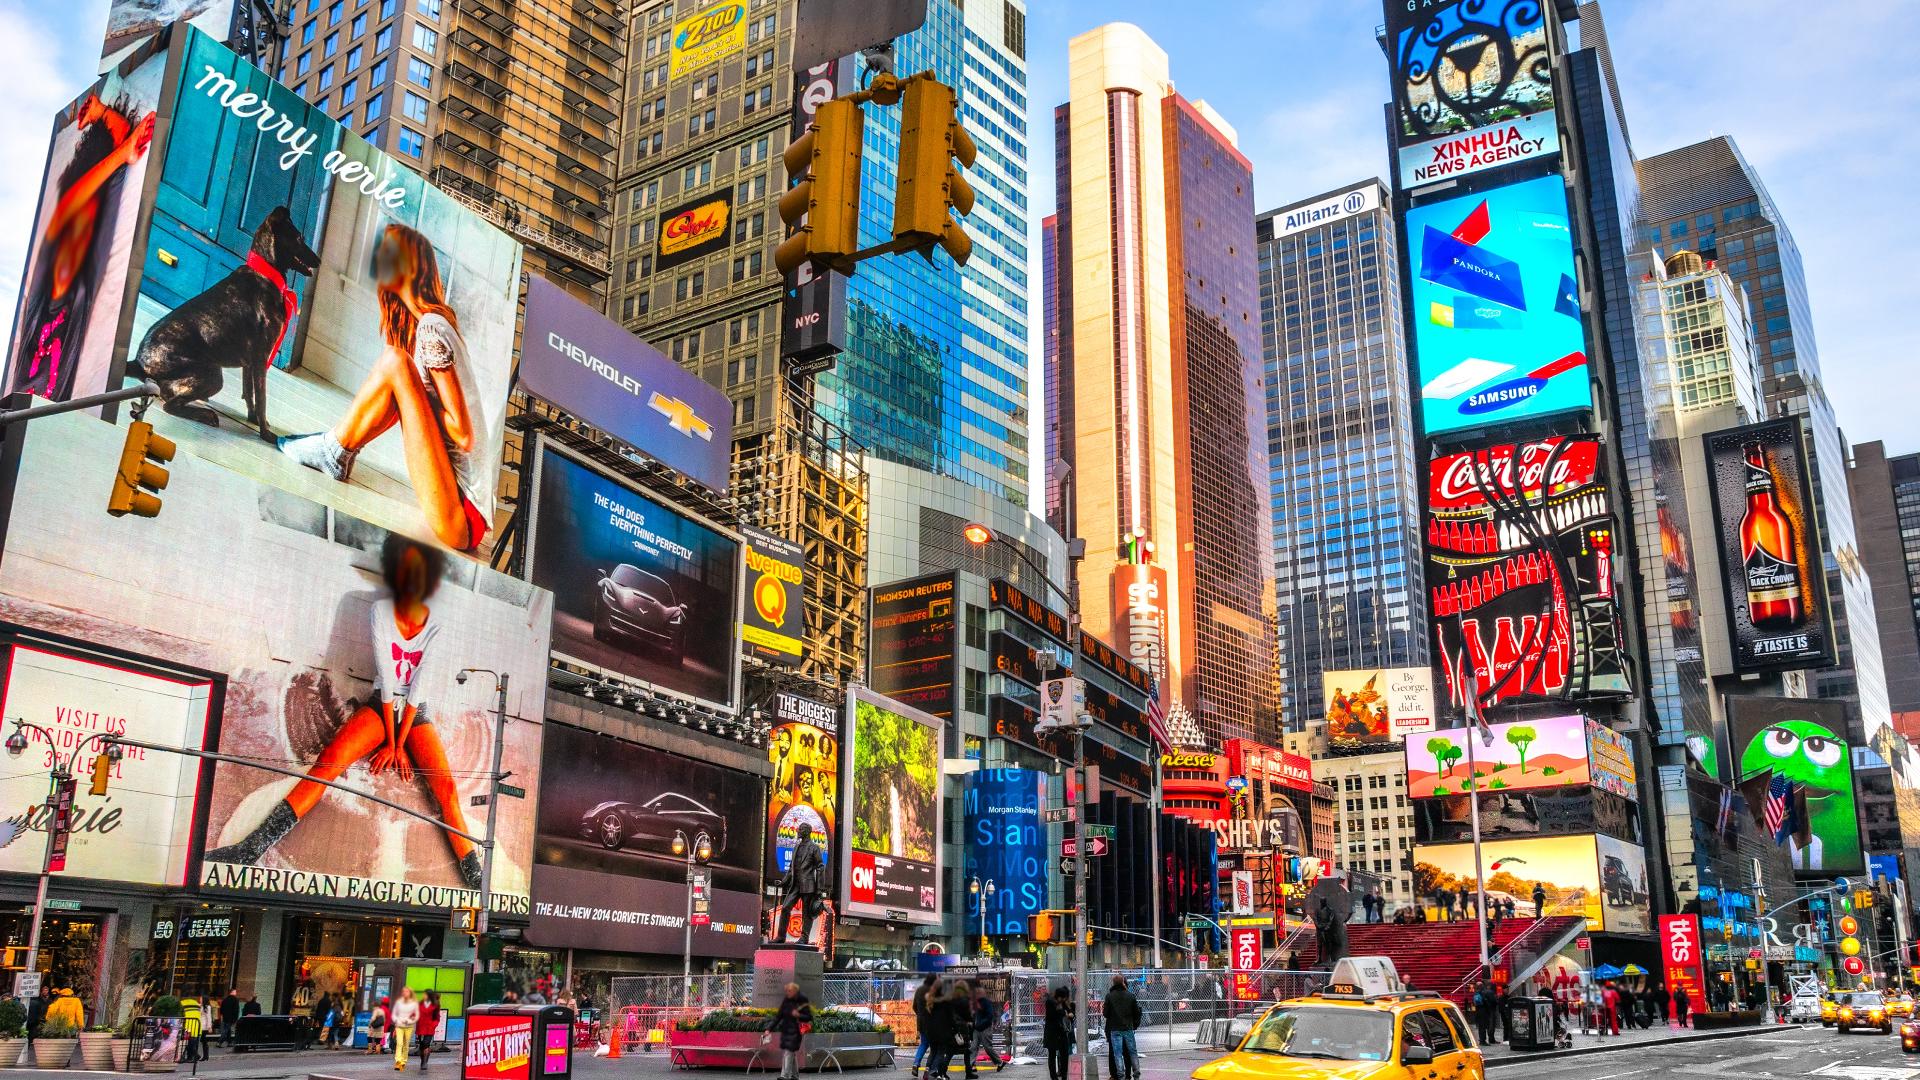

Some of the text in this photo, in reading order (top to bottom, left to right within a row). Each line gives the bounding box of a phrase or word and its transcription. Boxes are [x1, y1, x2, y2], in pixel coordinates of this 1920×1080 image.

[681, 4, 739, 52] Z100
[195, 65, 406, 208] merry aerie
[1432, 126, 1523, 162] XINHUA
[1414, 137, 1545, 181] NEWS AGENCY
[1285, 203, 1340, 230] Allianz
[1453, 257, 1502, 281] PANDORA
[795, 311, 820, 329] NYC
[548, 331, 642, 396] CHEVROLET
[1469, 384, 1538, 407] SAMSUNG
[594, 493, 645, 526] THE CAR DOES
[610, 514, 693, 561] EVERYTHING PERFECTLY
[745, 544, 803, 585] Avenue
[876, 580, 953, 604] THOMSON REUTERS
[1750, 573, 1795, 587] BLACK CROWN
[753, 572, 787, 628] Q
[1007, 587, 1023, 613] N/A
[1028, 601, 1043, 624] N/A
[1753, 636, 1808, 654] #TASTE IS
[1391, 683, 1428, 694] George,
[1403, 672, 1415, 683] By
[776, 693, 837, 724] THE BIGGEST
[1398, 702, 1424, 712] did it.
[1403, 693, 1417, 701] we
[56, 706, 127, 735] VISIT US
[1395, 718, 1428, 726] LEADERSHIP
[77, 756, 123, 779] LEL
[1161, 747, 1217, 767] Reese's
[988, 806, 1037, 816] Morgan Stanley
[1053, 810, 1060, 821] 46
[205, 863, 340, 898] AMERICAN
[347, 877, 413, 905] EAGLE
[852, 866, 874, 890] CNN
[535, 902, 685, 929] THE ALL-NEW 2014 CORVETTE STINGRAY
[188, 918, 232, 938] JEANS
[710, 921, 754, 935] FIND NEW ROADS
[1239, 932, 1256, 970] tkts
[1668, 918, 1693, 963] tkts
[1334, 984, 1353, 994] 7K53
[466, 1034, 503, 1067] JERSEY
[505, 1030, 532, 1061] BOYS
